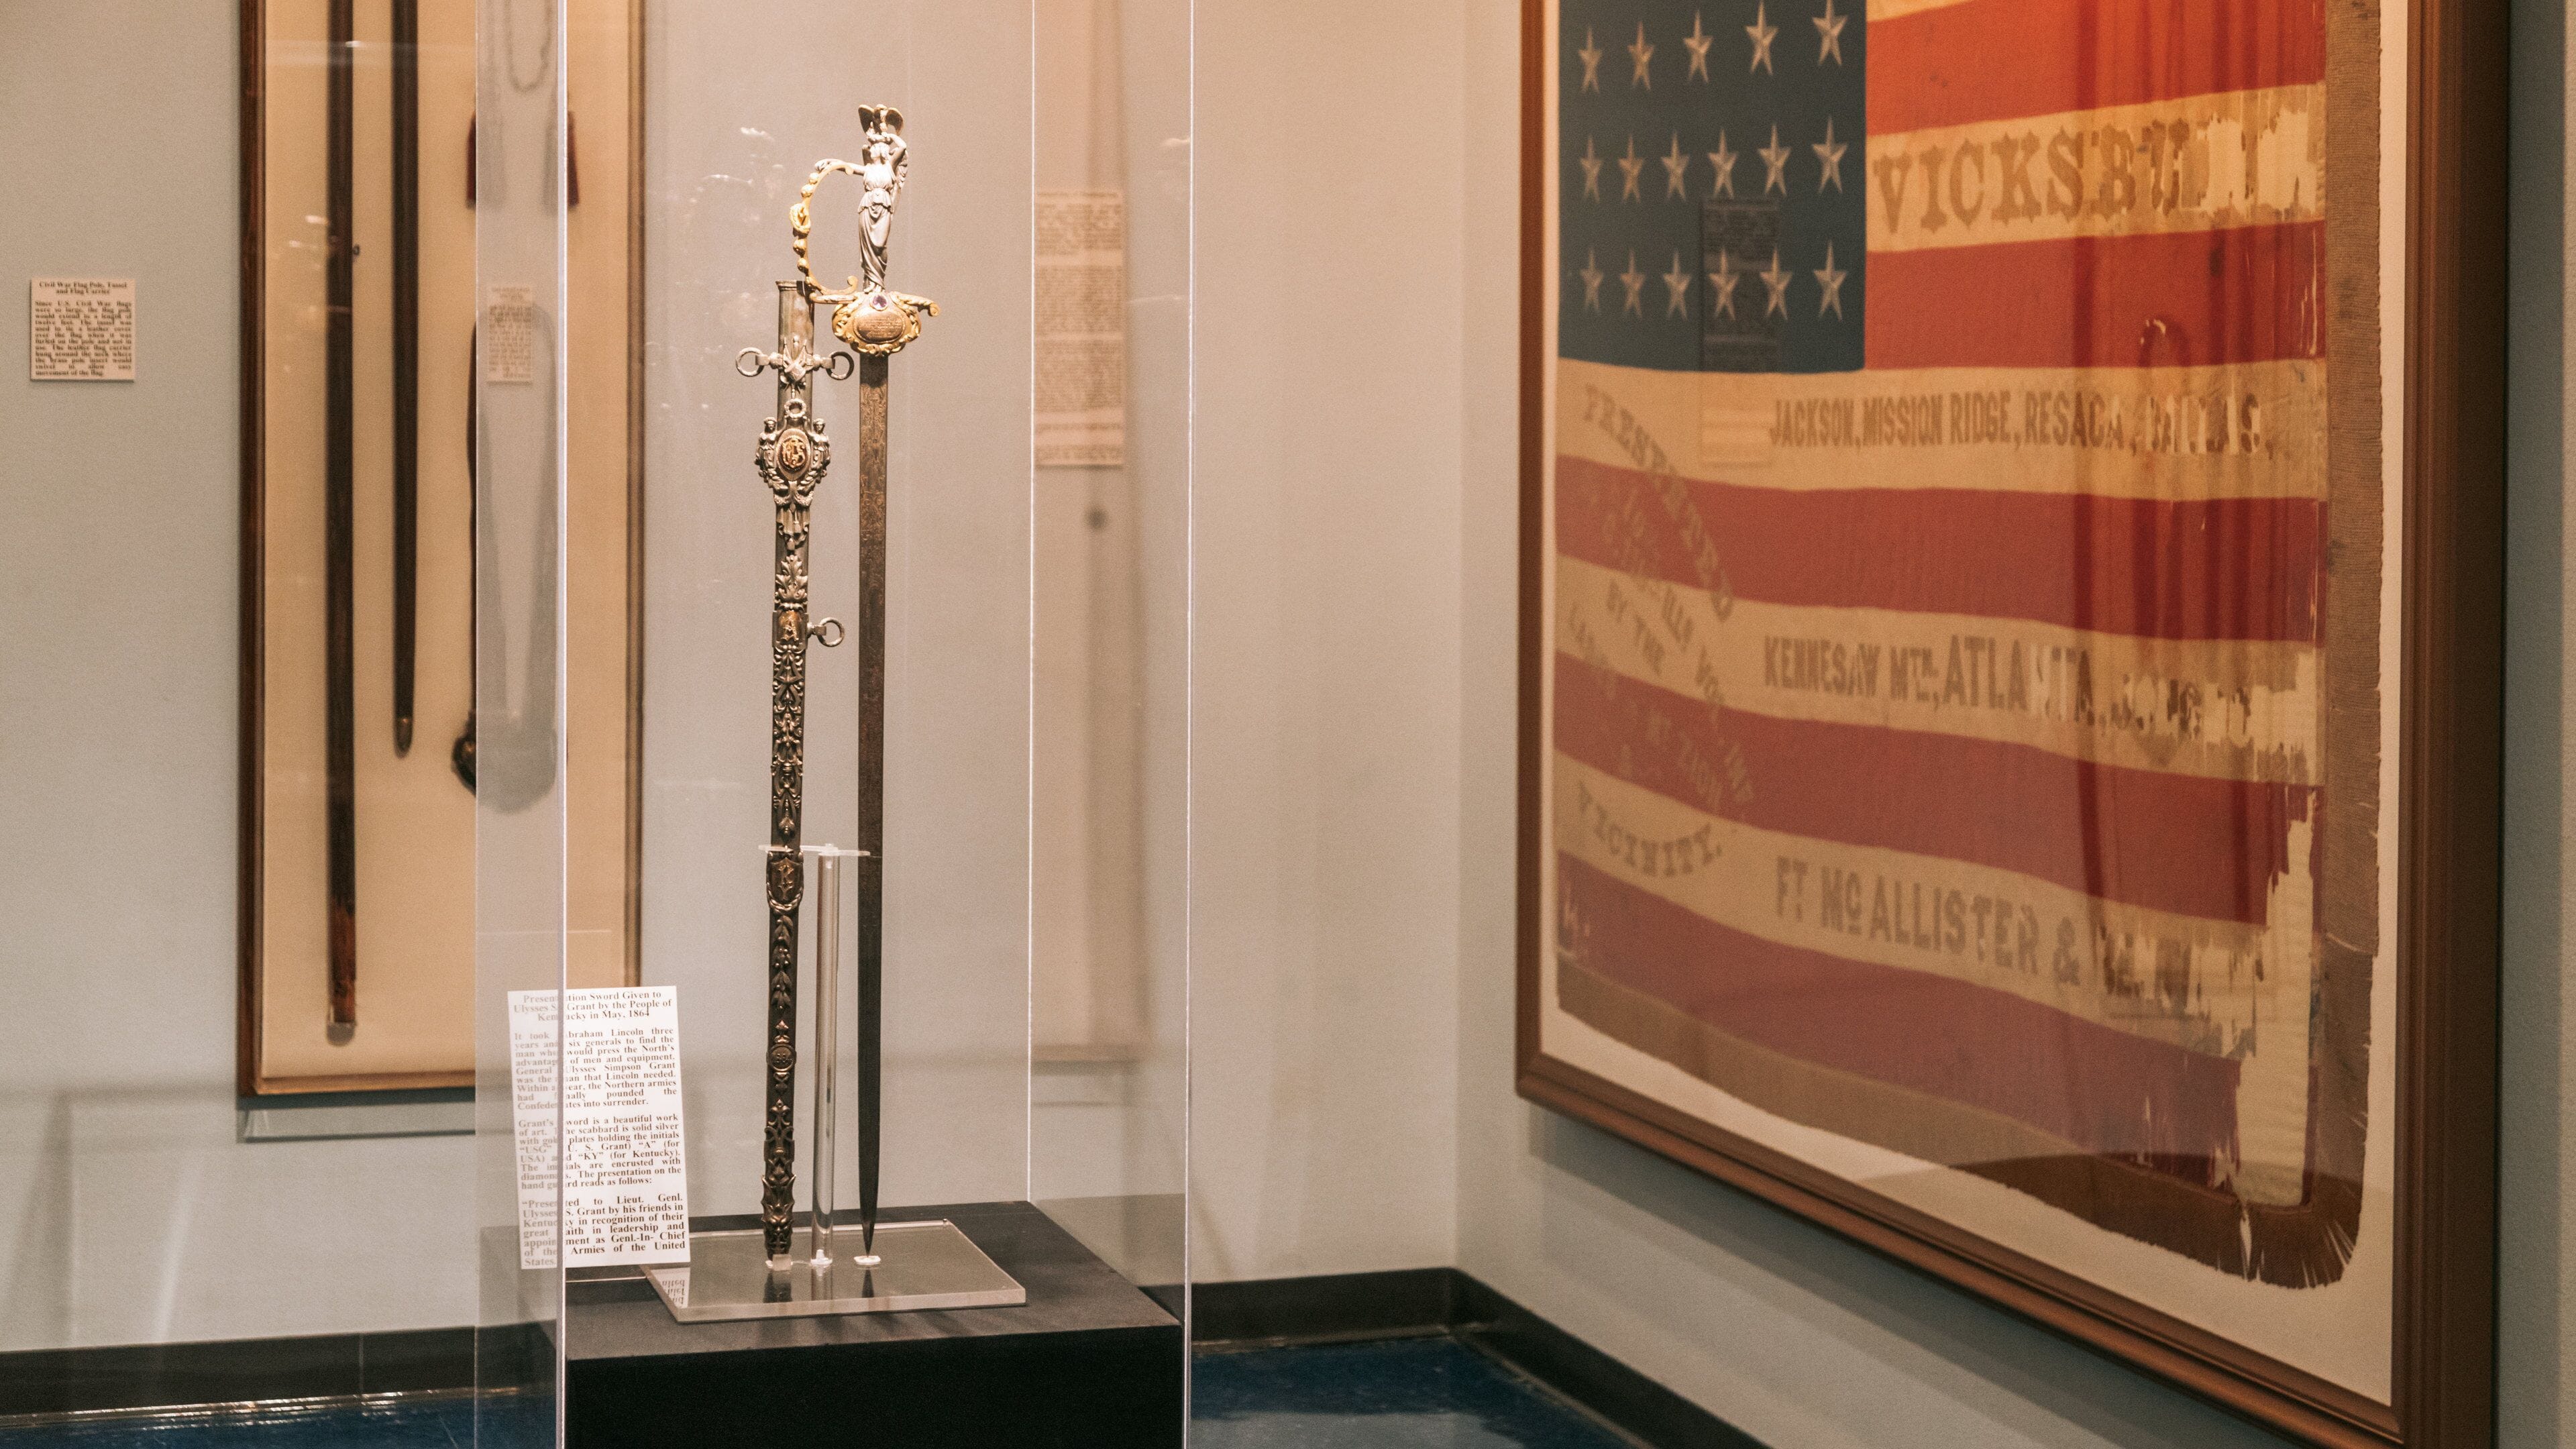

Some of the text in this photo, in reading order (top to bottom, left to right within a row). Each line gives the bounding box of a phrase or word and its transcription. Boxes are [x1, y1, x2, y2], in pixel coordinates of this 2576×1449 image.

[1863, 394, 1943, 447] MISSION
[1949, 390, 2022, 451] RIDGE,
[1868, 874, 2040, 975] ALLISTER
[2052, 916, 2080, 987] &
[590, 992, 619, 1000] Sword
[623, 991, 649, 1000] Given
[514, 999, 672, 1014] Ulysses Grant by the People of
[629, 1009, 649, 1018] 1864
[530, 1032, 549, 1040] took
[611, 1028, 643, 1036] Lincoln
[586, 1037, 621, 1047] generals
[566, 1047, 592, 1055] would
[598, 1049, 620, 1057] press
[515, 1059, 557, 1067] advantag
[627, 1053, 675, 1063] equipment.
[516, 1067, 552, 1075] General
[604, 1063, 641, 1073] Simpson
[649, 1062, 676, 1070] Grant
[606, 1072, 639, 1080] Lincoln
[643, 1070, 676, 1078] needed.
[517, 1083, 548, 1092] Within
[588, 1081, 601, 1089] the
[605, 1080, 644, 1088] Northern
[648, 1079, 676, 1087] armies
[517, 1093, 535, 1102] had
[606, 1089, 644, 1099] pounded
[584, 1098, 649, 1108] into surrender.
[613, 1114, 652, 1124] beautiful
[656, 1114, 678, 1122] work
[519, 1128, 528, 1136] of
[578, 1125, 619, 1134] scabbard
[632, 1123, 652, 1131] solid
[655, 1122, 679, 1130] silver
[519, 1136, 539, 1145] with
[569, 1136, 594, 1145] plates
[598, 1134, 631, 1142] holding
[650, 1131, 680, 1140] initials
[585, 1143, 594, 1151] S.
[601, 1142, 631, 1150] Grant)
[663, 1140, 680, 1148] (for
[521, 1155, 545, 1163] USA)
[610, 1151, 626, 1161] (for
[633, 1149, 680, 1159] Kentucky).
[521, 1164, 538, 1172] The
[611, 1159, 653, 1168] encrusted
[662, 1157, 681, 1165] with
[579, 1170, 594, 1179] The
[598, 1168, 651, 1181] presentation
[668, 1166, 682, 1174] the
[521, 1181, 544, 1190] hand
[581, 1178, 604, 1187] reads
[619, 1177, 652, 1185] follows:
[594, 1193, 683, 1205] to Lieut. Genl.
[566, 1208, 574, 1216] S.
[577, 1207, 606, 1216] Grant
[608, 1206, 620, 1216] by
[623, 1205, 636, 1213] his
[639, 1203, 672, 1213] friends
[674, 1203, 683, 1211] in
[523, 1219, 574, 1228] Kentucy
[592, 1214, 644, 1226] recognition
[649, 1213, 658, 1221] of
[662, 1212, 684, 1220] their
[523, 1230, 549, 1238] great
[592, 1226, 601, 1234] in
[610, 1223, 659, 1234] leadership
[667, 1222, 684, 1230] and
[524, 1237, 590, 1248] appoinment
[659, 1231, 686, 1240] Chief
[525, 1241, 685, 1256] of the Armies of the United
